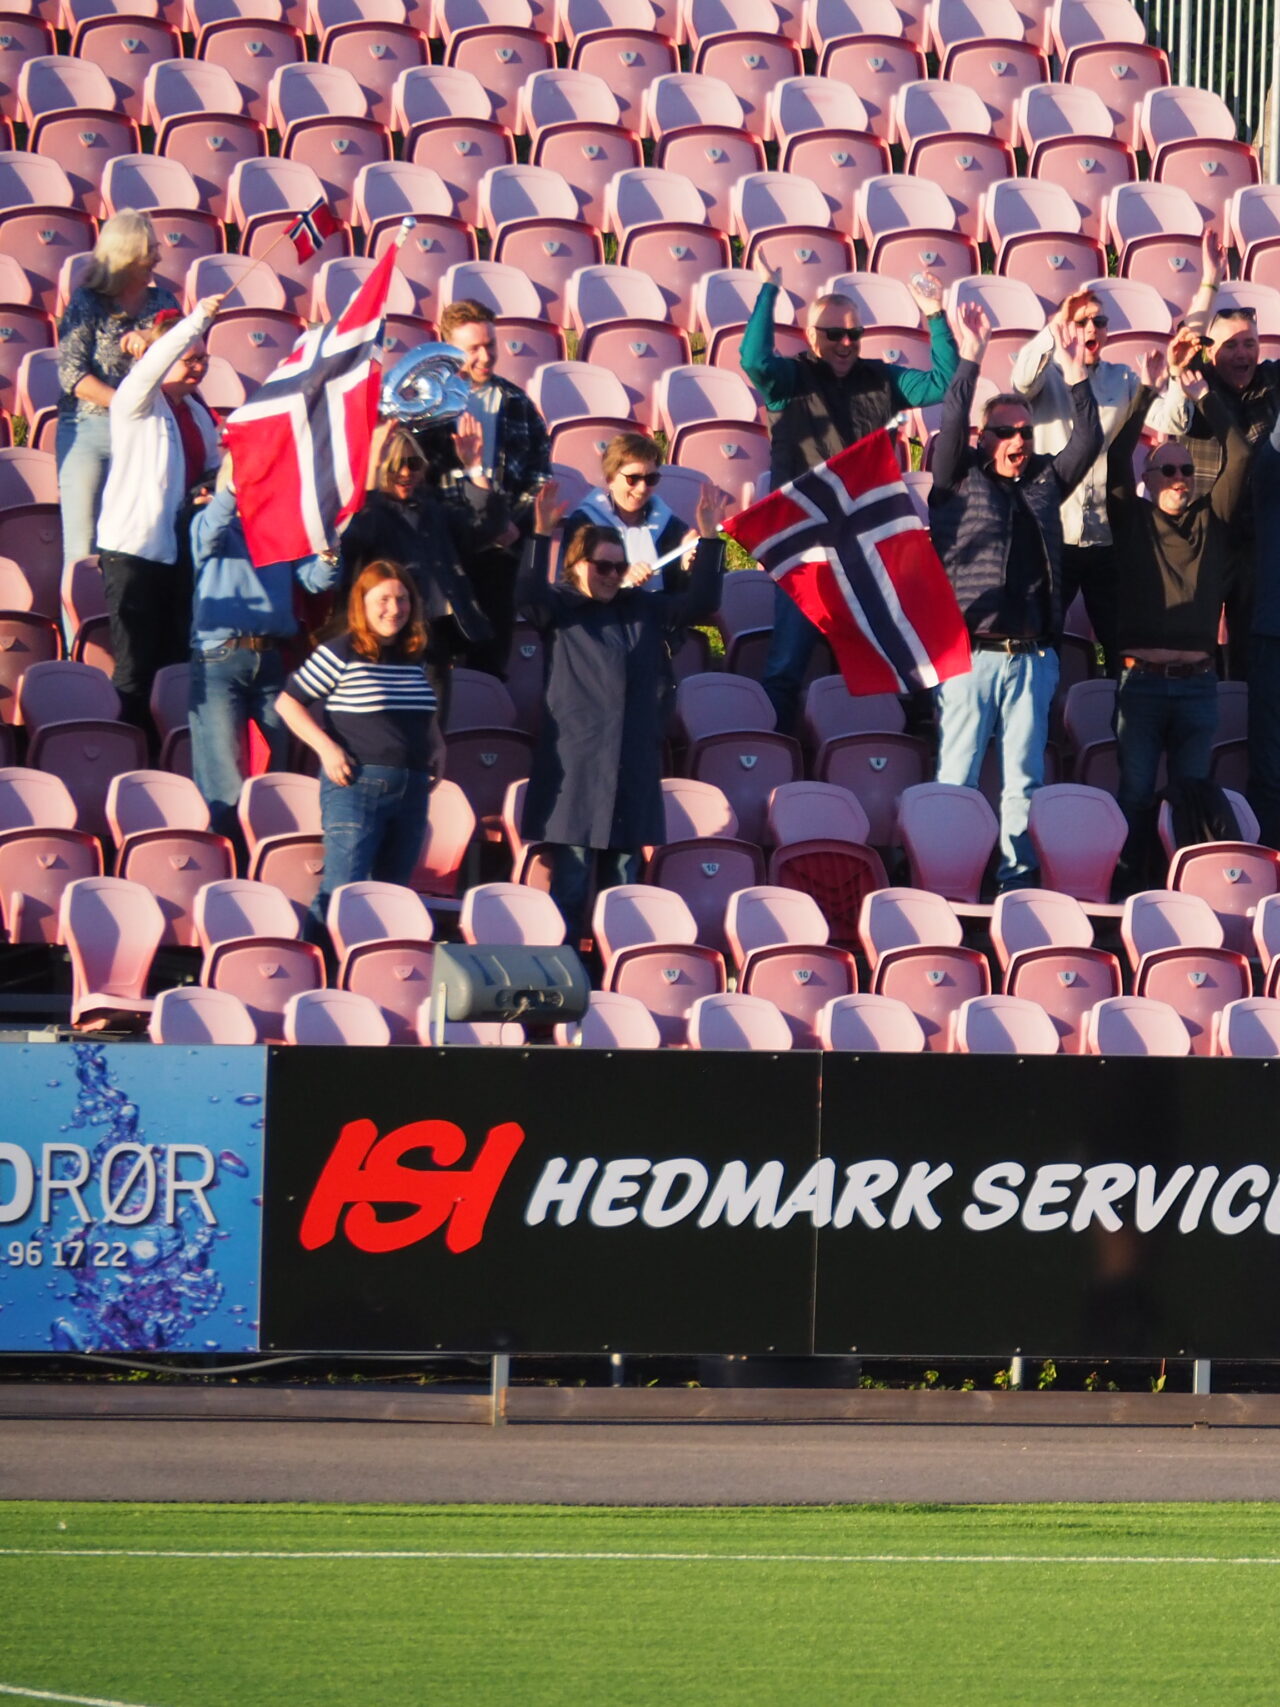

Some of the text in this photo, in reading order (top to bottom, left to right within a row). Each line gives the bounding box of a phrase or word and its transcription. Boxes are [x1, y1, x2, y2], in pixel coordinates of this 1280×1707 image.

[524, 1156, 954, 1231] HEDMARK
[8, 1241, 128, 1267] 96 17 22
